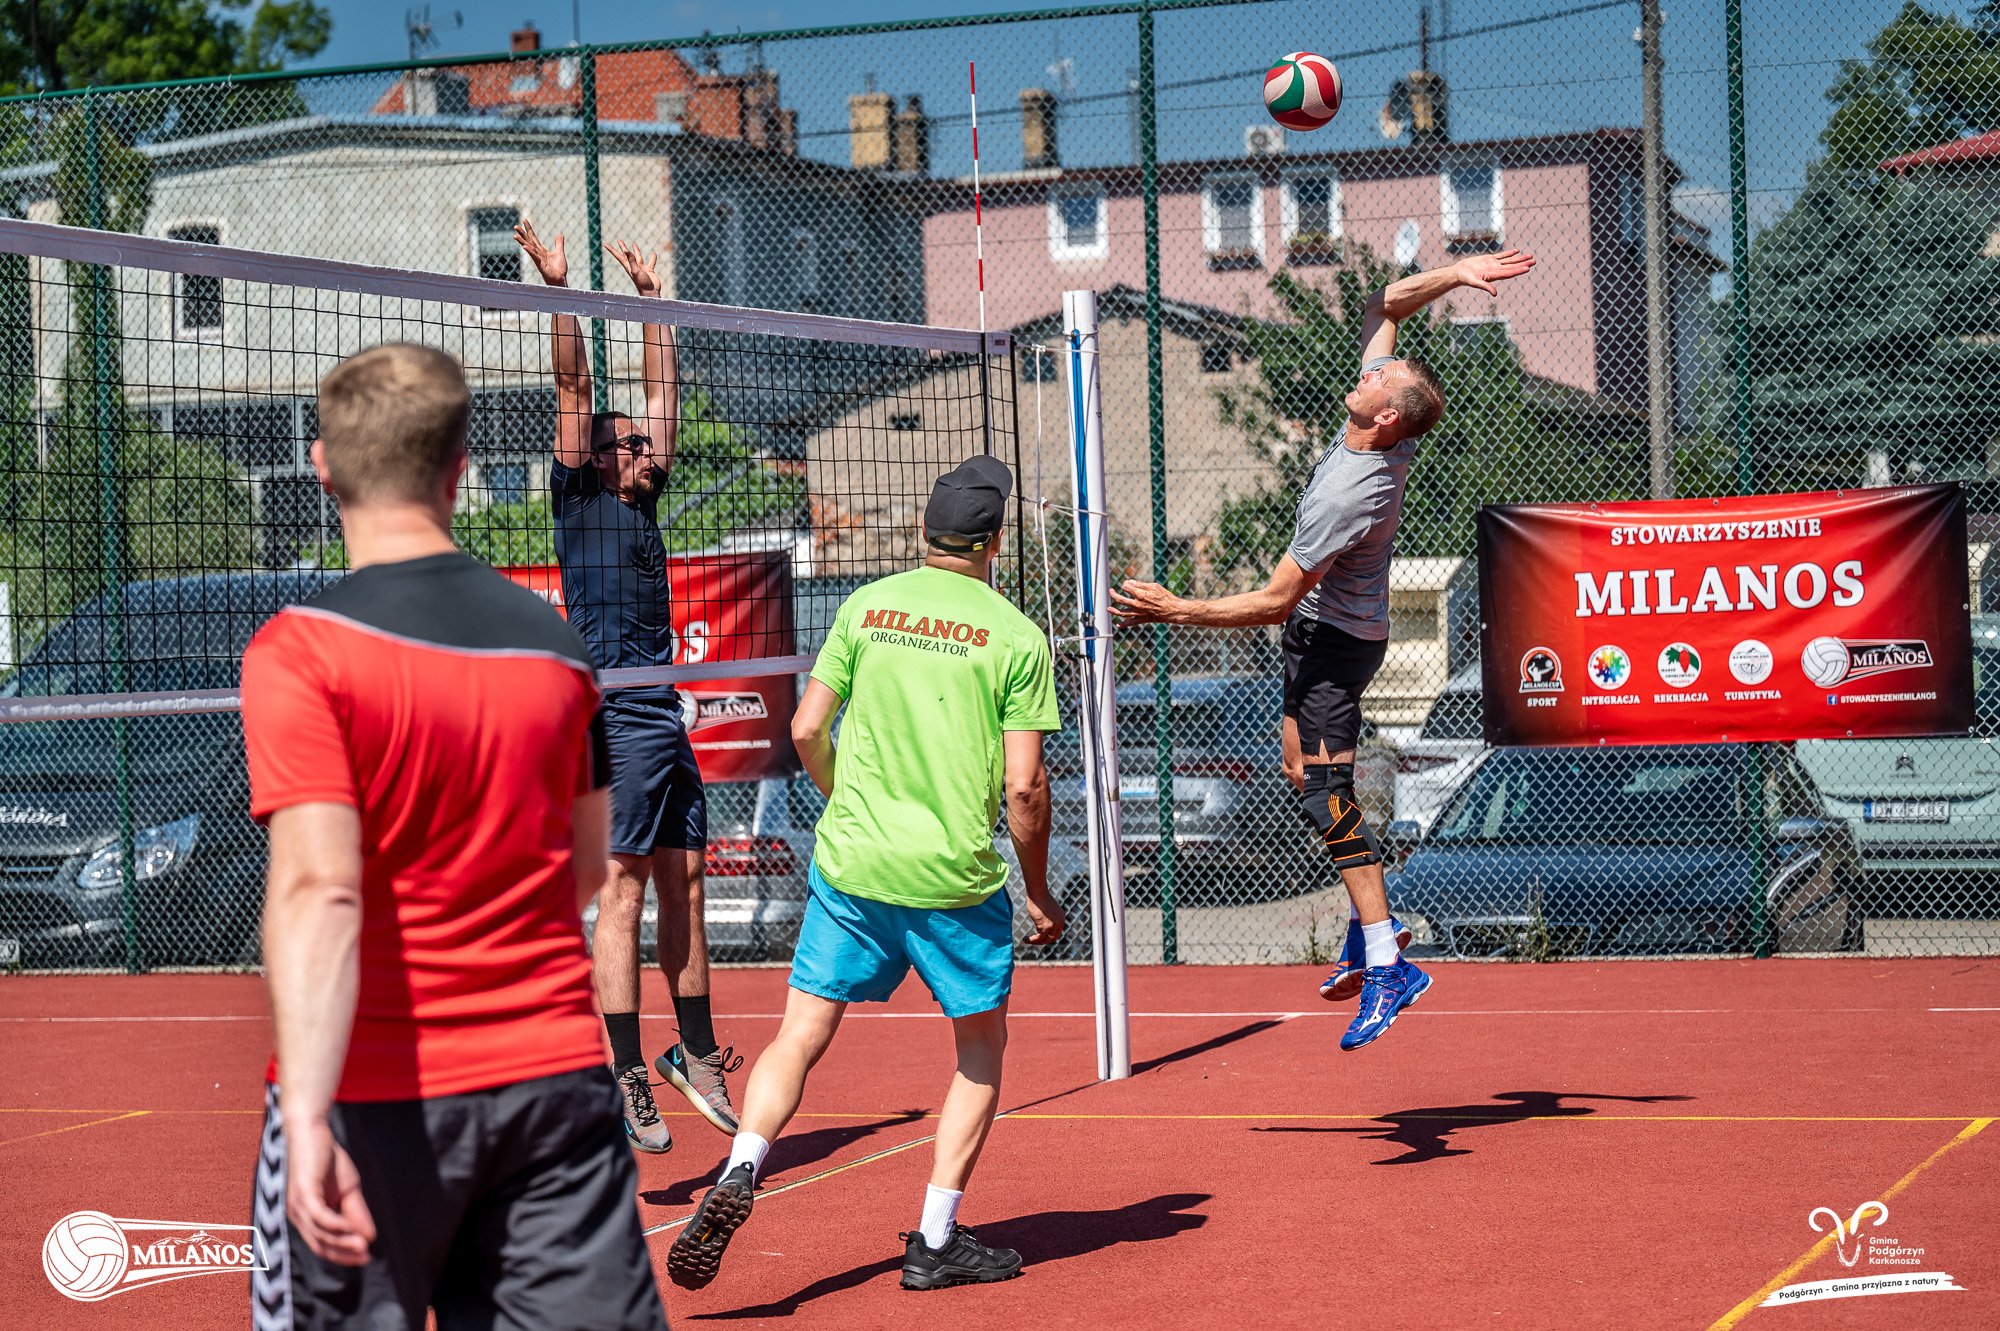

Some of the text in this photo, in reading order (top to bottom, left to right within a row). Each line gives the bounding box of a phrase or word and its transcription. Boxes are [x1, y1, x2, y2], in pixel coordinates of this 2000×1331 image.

[1610, 518, 1822, 546] STOWARZYSZENIE
[1573, 559, 1866, 618] MILANOS
[861, 609, 990, 647] MILANOS
[870, 631, 969, 657] ORGANIZATOR
[1853, 650, 1927, 667] MILANOS
[1527, 697, 1558, 707] SPORT
[1581, 695, 1641, 706] INTEGRACJA
[1653, 692, 1709, 703] REKREACJA
[1724, 690, 1782, 701] TURYSTYKA
[1840, 691, 1937, 704] STOWARZYSZENIEMILANOS
[700, 702, 762, 717] MILANOS
